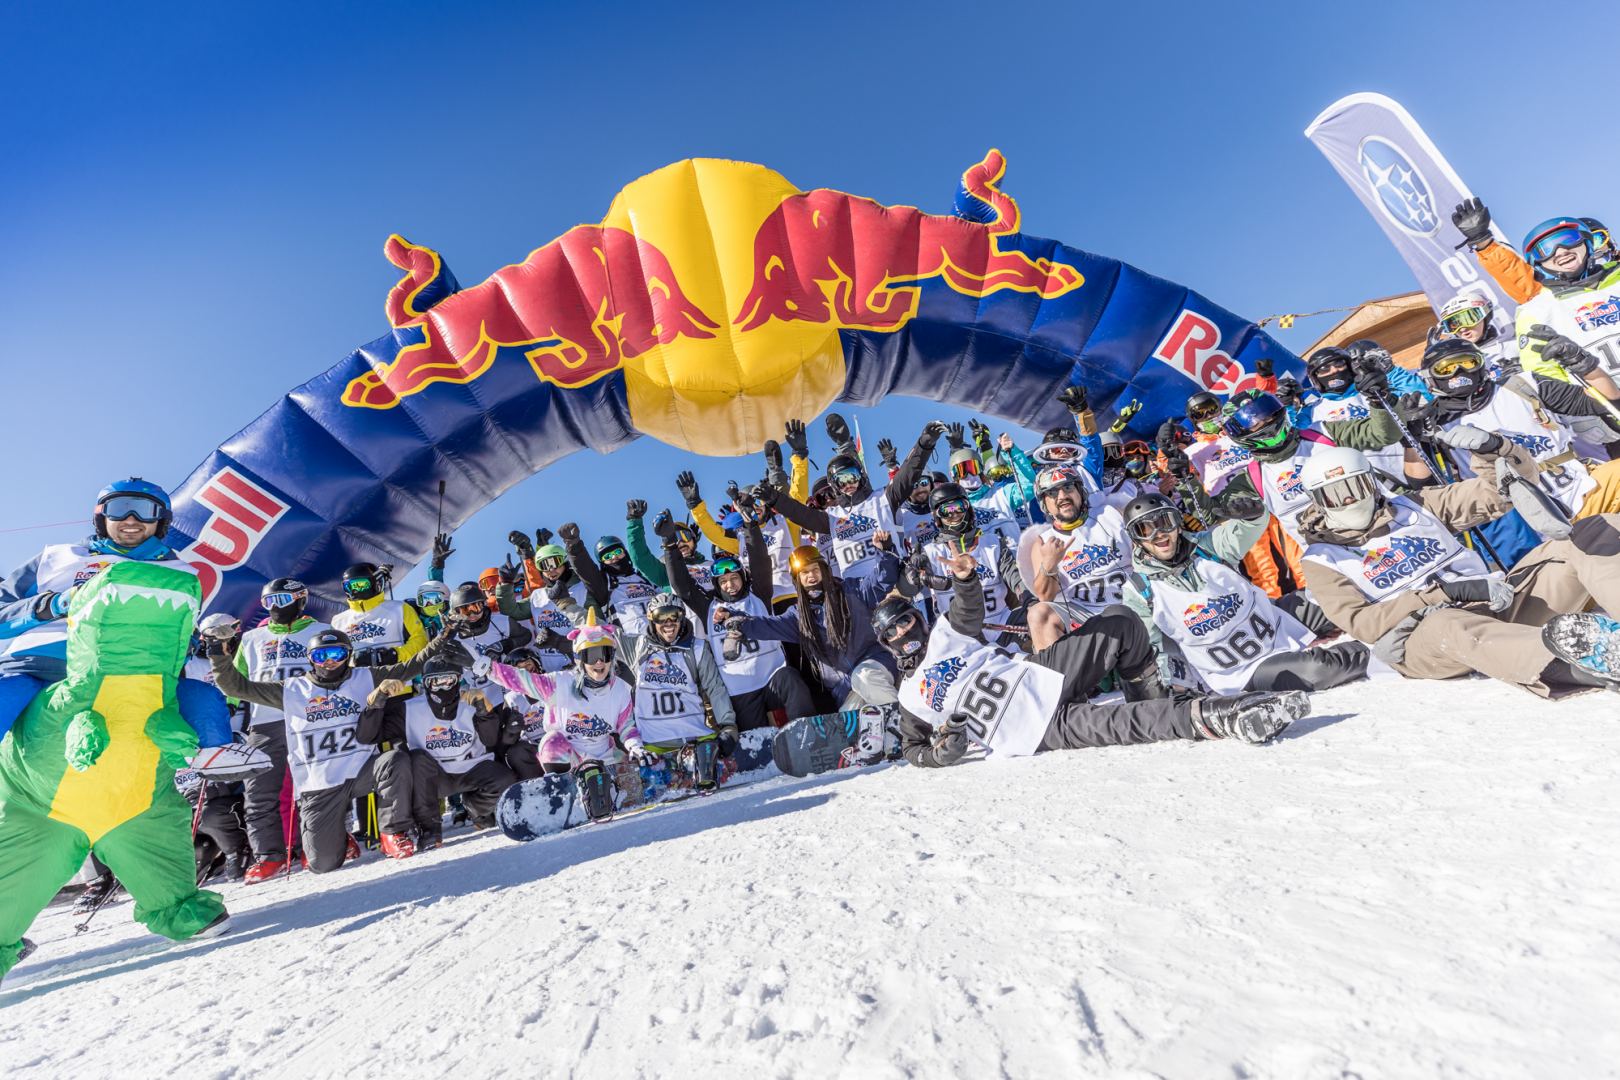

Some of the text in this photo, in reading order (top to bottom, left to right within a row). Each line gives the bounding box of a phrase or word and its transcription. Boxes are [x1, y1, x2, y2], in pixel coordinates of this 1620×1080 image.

[1207, 613, 1275, 669] 064
[652, 692, 685, 715] 101
[305, 728, 357, 758] 142
